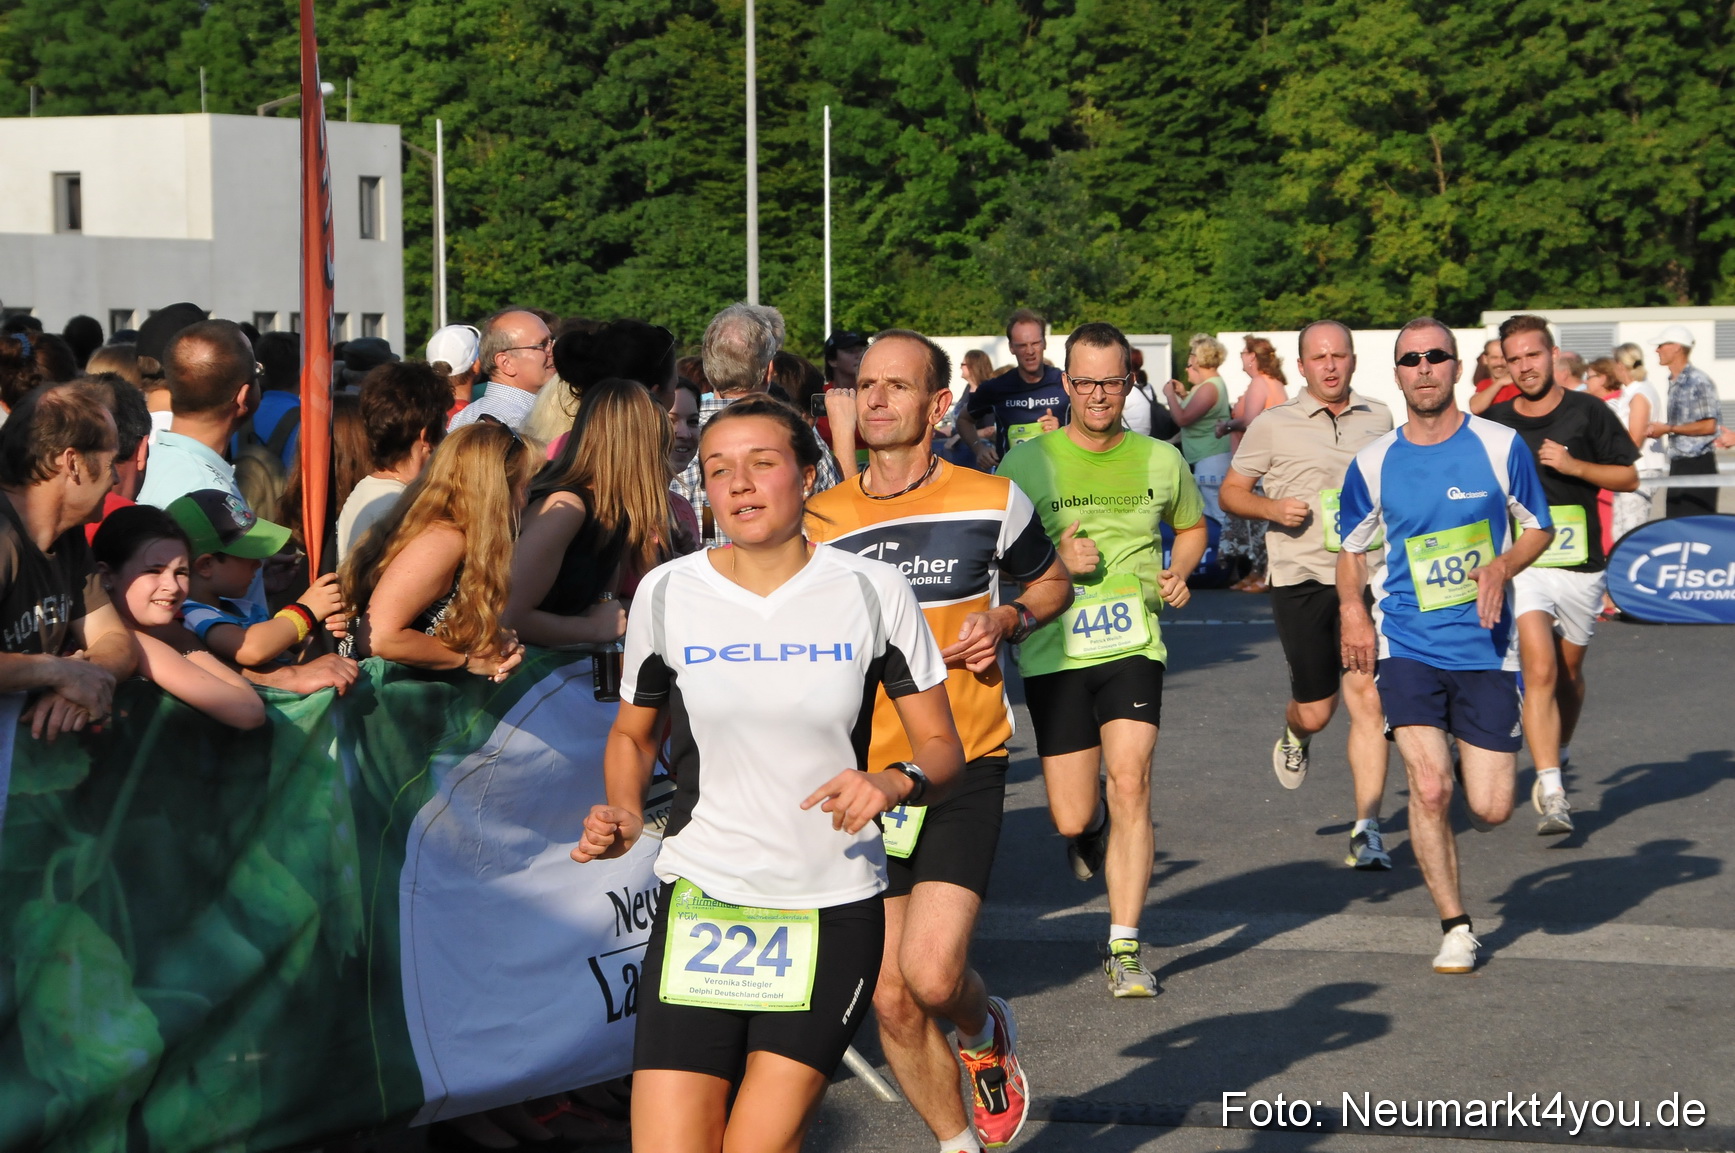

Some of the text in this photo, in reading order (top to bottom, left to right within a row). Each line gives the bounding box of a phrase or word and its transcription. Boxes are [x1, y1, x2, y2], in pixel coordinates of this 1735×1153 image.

[1005, 396, 1060, 407] EURO POLES
[1426, 550, 1481, 588] 482
[1072, 602, 1132, 638] 448
[684, 643, 853, 665] DELPHI
[684, 922, 793, 978] 224
[689, 987, 784, 999] Delphi Deutschland GmbH
[704, 977, 773, 989] Veronika Stiegler
